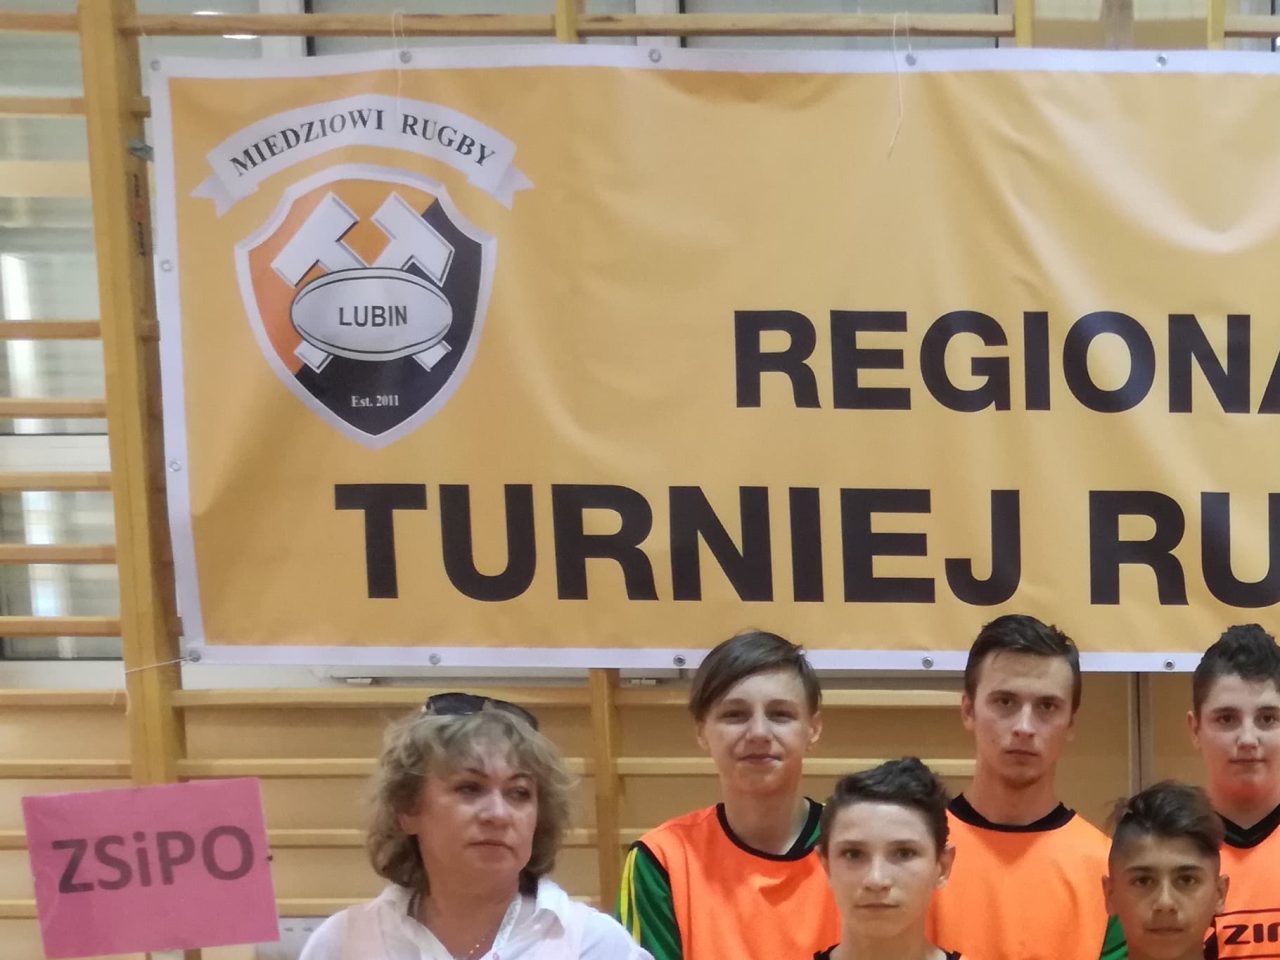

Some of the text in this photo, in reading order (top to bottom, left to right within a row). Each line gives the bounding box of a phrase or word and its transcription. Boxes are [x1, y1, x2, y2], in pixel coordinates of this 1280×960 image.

[229, 108, 496, 177] MIEDZIOWI RUGBY
[338, 304, 408, 328] LUBIN
[351, 394, 400, 408] Est. 2011
[334, 482, 1022, 606] TURNIEJ
[51, 824, 255, 895] ZSiPO
